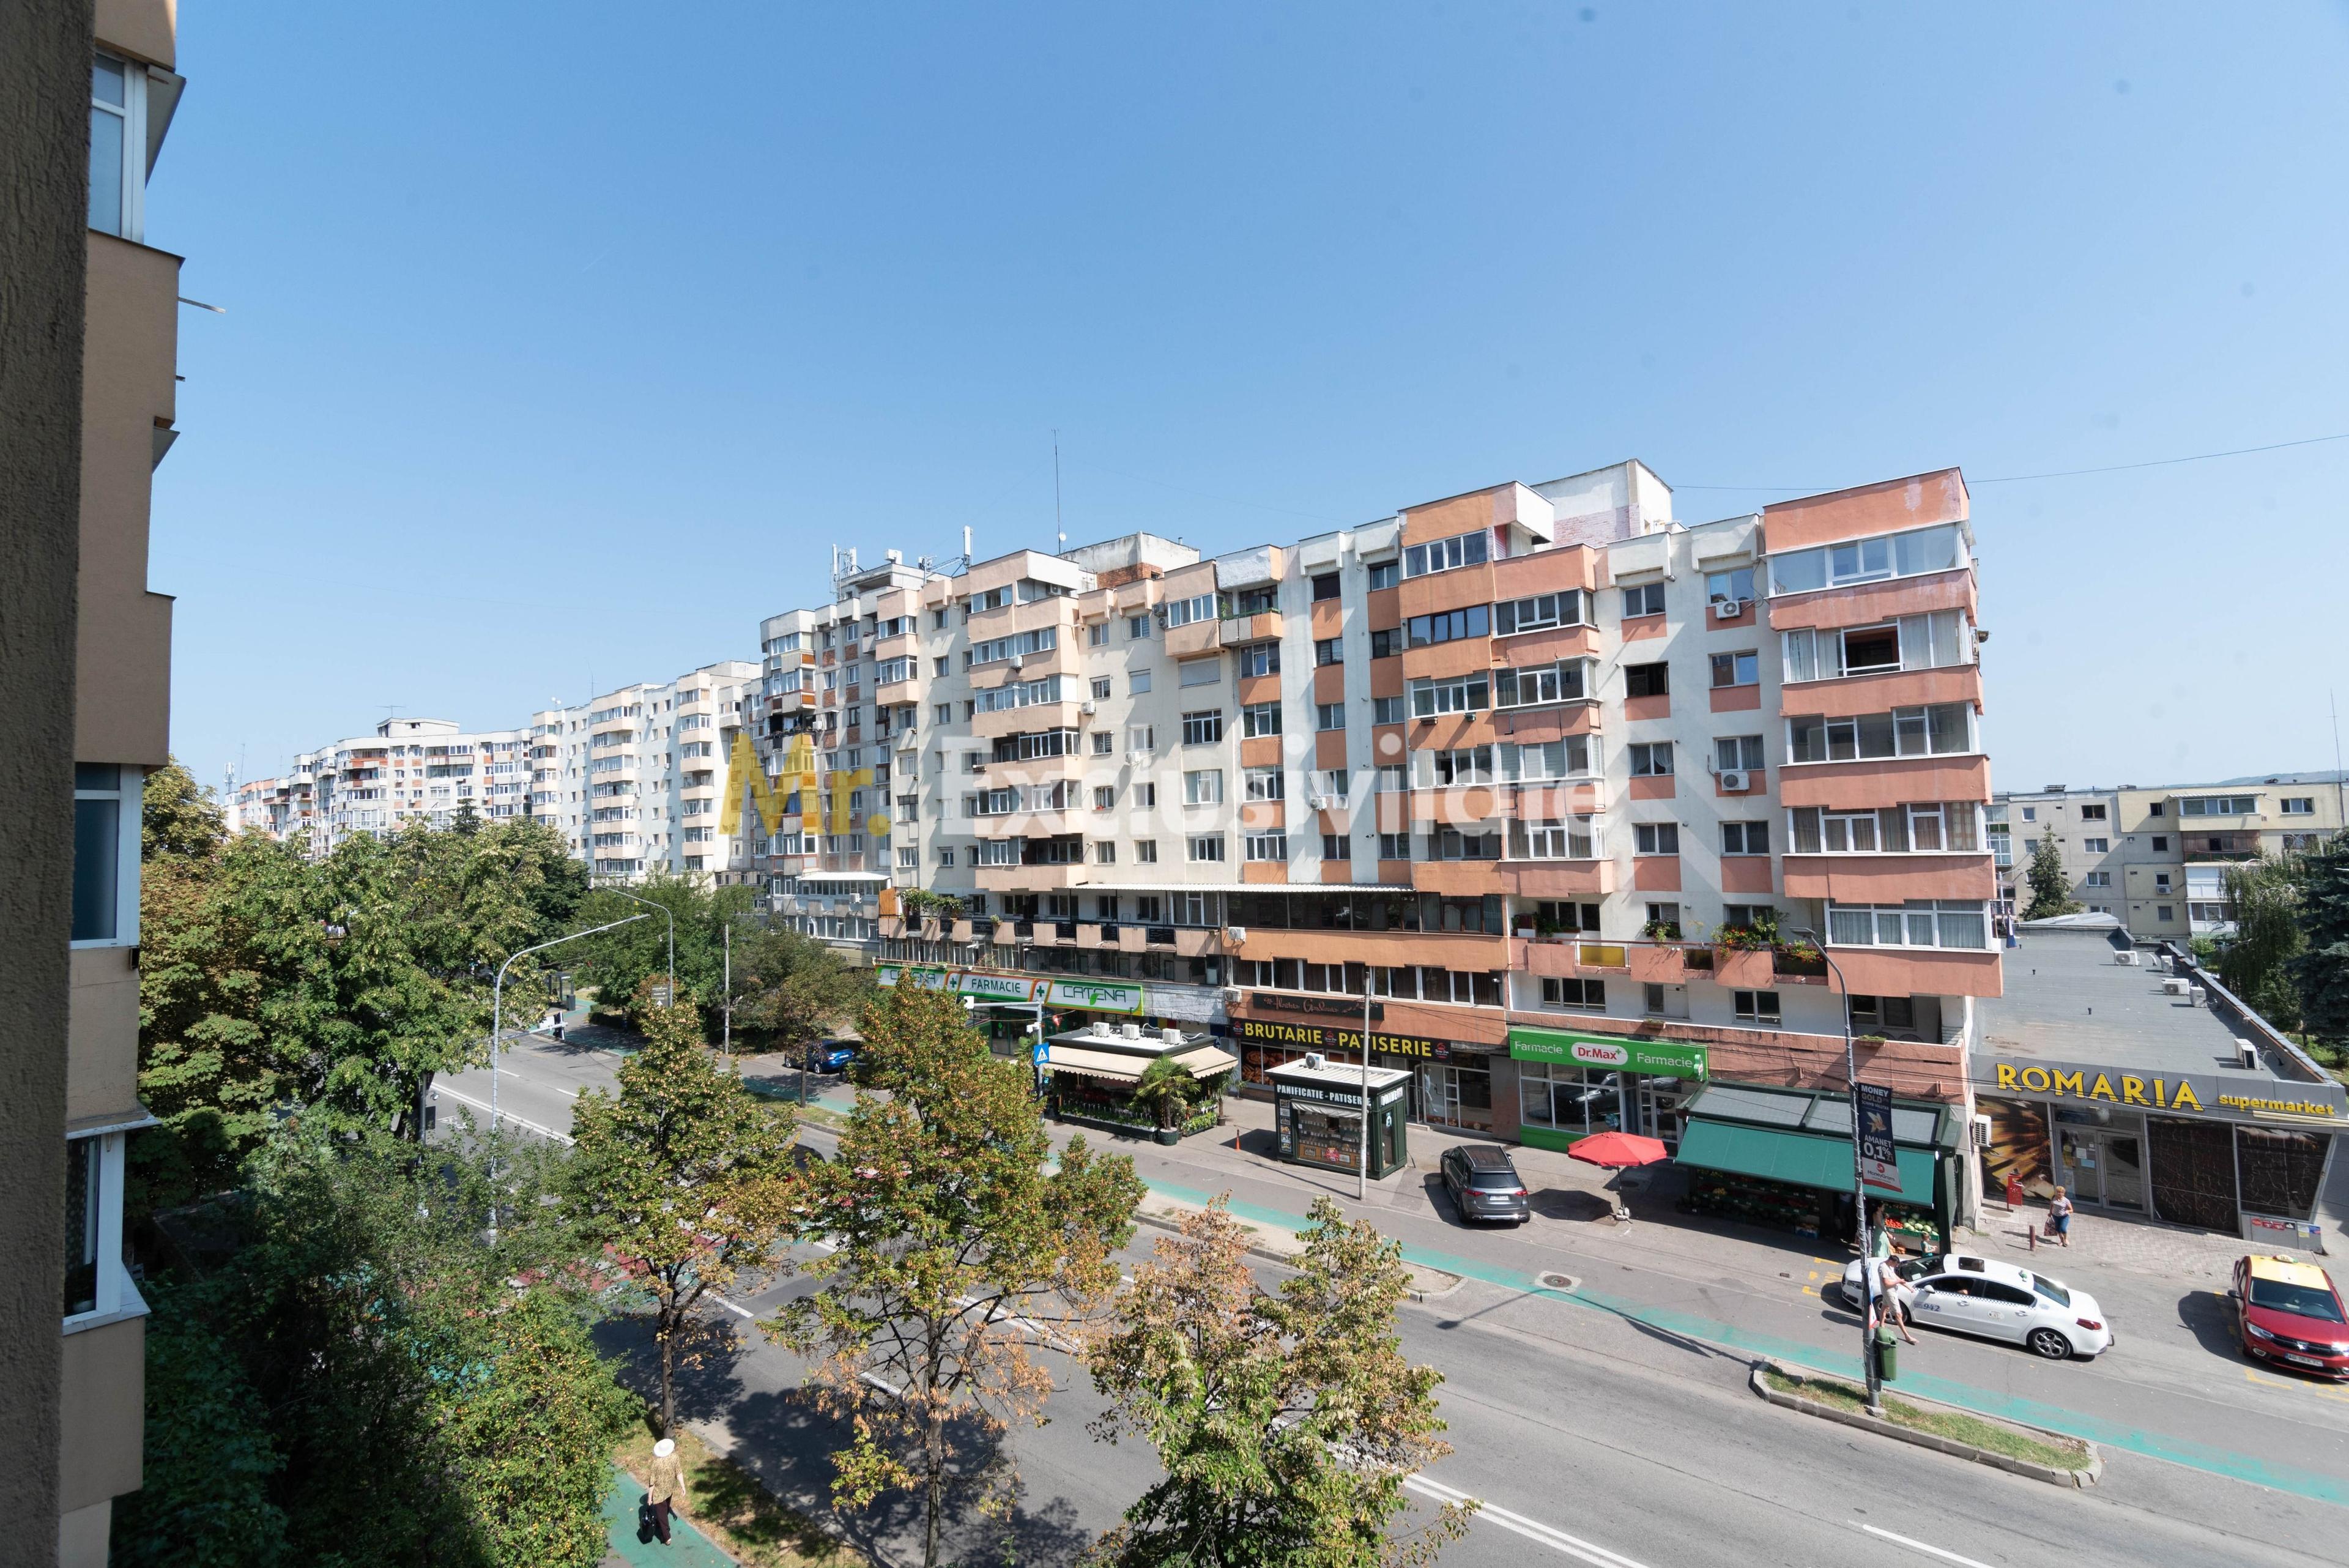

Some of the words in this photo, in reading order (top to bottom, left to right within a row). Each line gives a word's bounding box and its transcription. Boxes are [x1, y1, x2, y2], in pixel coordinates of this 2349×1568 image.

[890, 970, 936, 984] CENA
[971, 978, 1021, 993] FARMACIE
[1063, 985, 1126, 1003] CATENA
[1244, 1022, 1323, 1044] BRUTARIE
[1515, 1041, 1563, 1054] Farmacie
[1578, 1047, 1617, 1060] Dr.Max
[1637, 1052, 1693, 1068] Farmacie
[1277, 1084, 1324, 1099] PANIFICATIE
[1329, 1092, 1371, 1106] PATISERE
[1861, 1085, 1888, 1097] MONEY
[1861, 1093, 1882, 1103] GOLD
[1996, 1063, 2205, 1112] ROMARIA
[2219, 1095, 2334, 1117] supermarket
[1865, 1134, 1892, 1148] AMANET
[1923, 1303, 1940, 1312] 942
